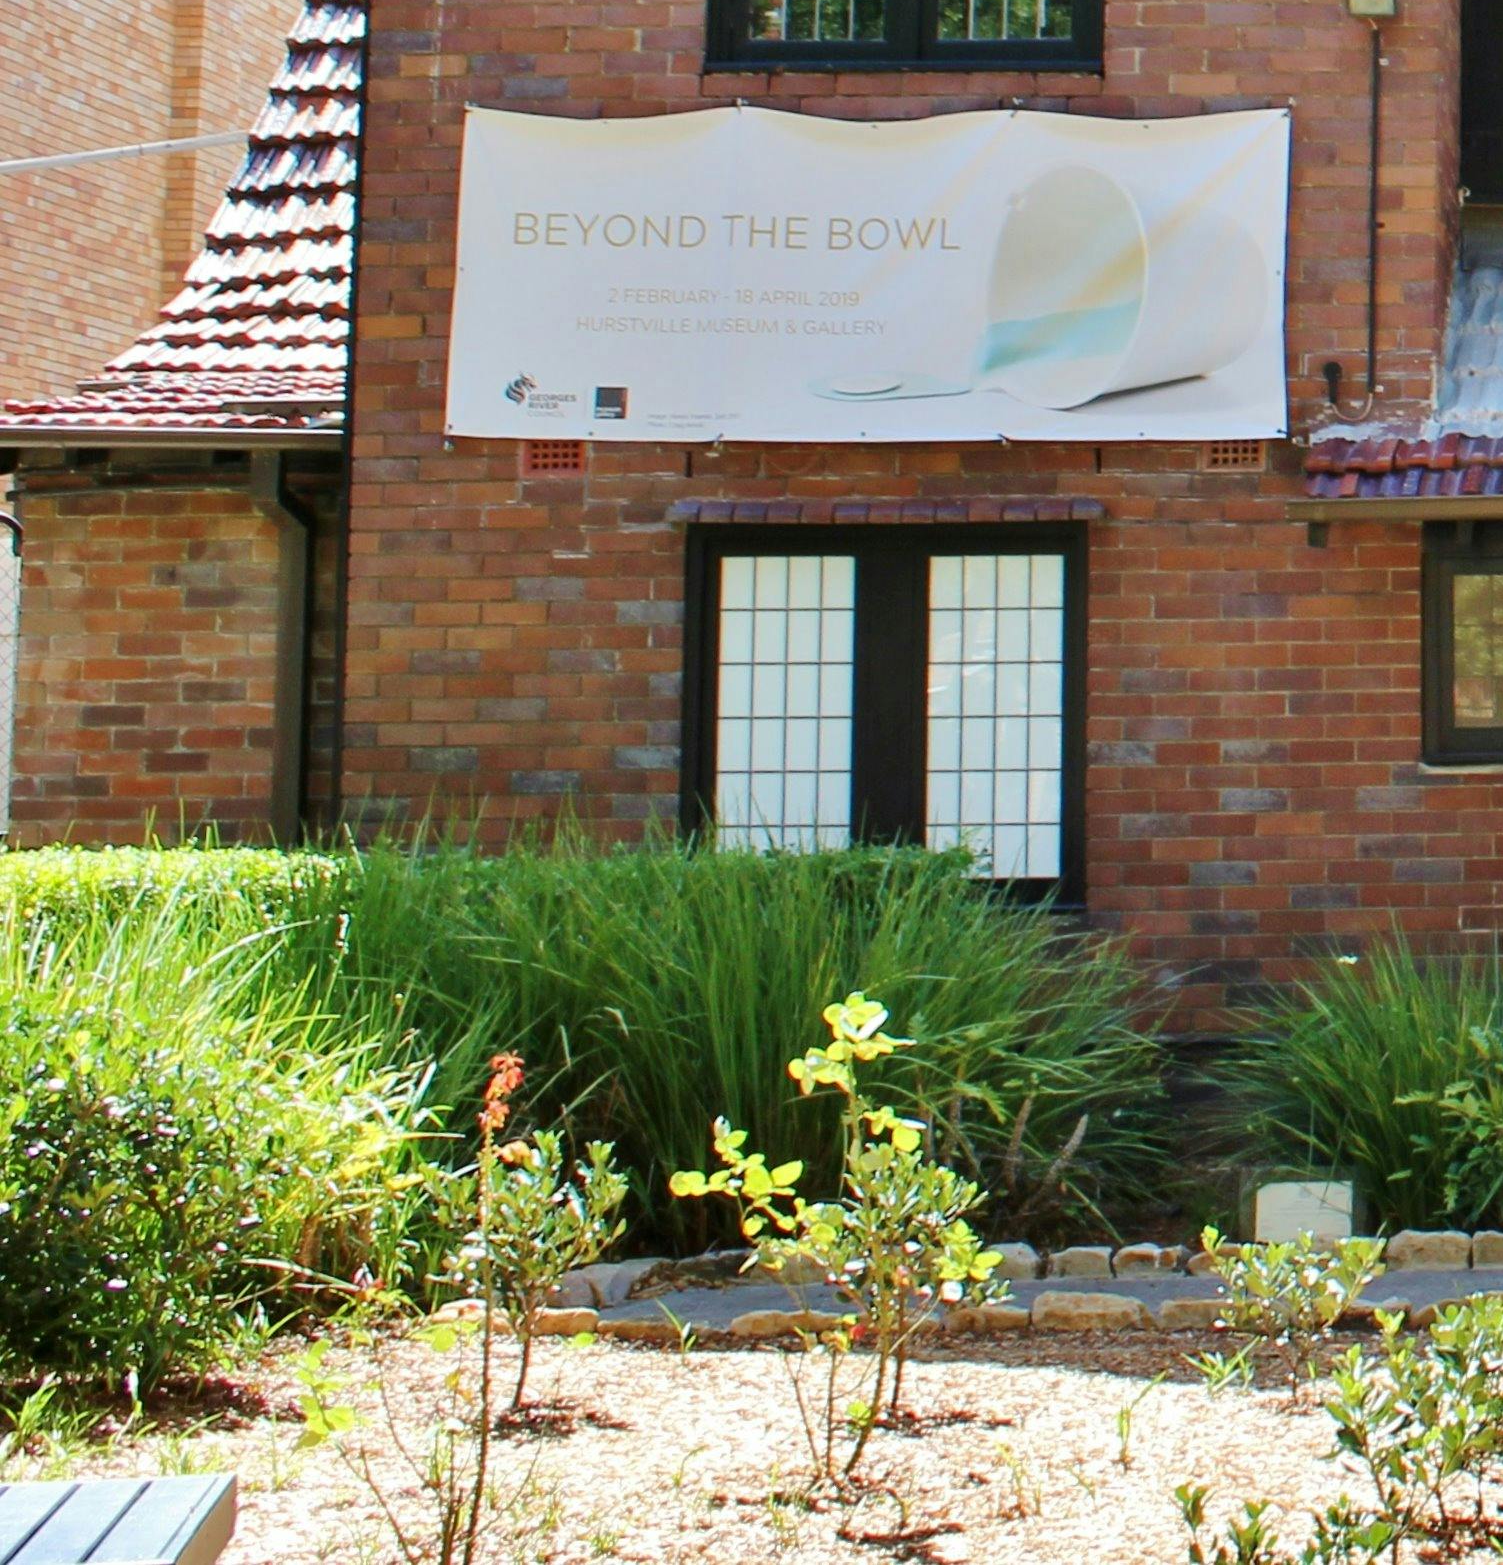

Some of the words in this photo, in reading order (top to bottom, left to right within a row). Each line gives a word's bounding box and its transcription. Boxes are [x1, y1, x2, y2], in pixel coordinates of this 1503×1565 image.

[512, 212, 707, 248] BEYOND
[722, 214, 809, 250] THE
[827, 217, 961, 251] BOWL
[607, 287, 618, 304] 2
[623, 288, 721, 305] FEBRUARY
[736, 288, 753, 305] 18
[759, 289, 812, 307] APRIL
[818, 291, 861, 307] 2019
[575, 315, 691, 334] HURSTVILLE
[696, 317, 779, 335] MUSEUM
[785, 318, 797, 335] &
[802, 319, 888, 337] GALLERY
